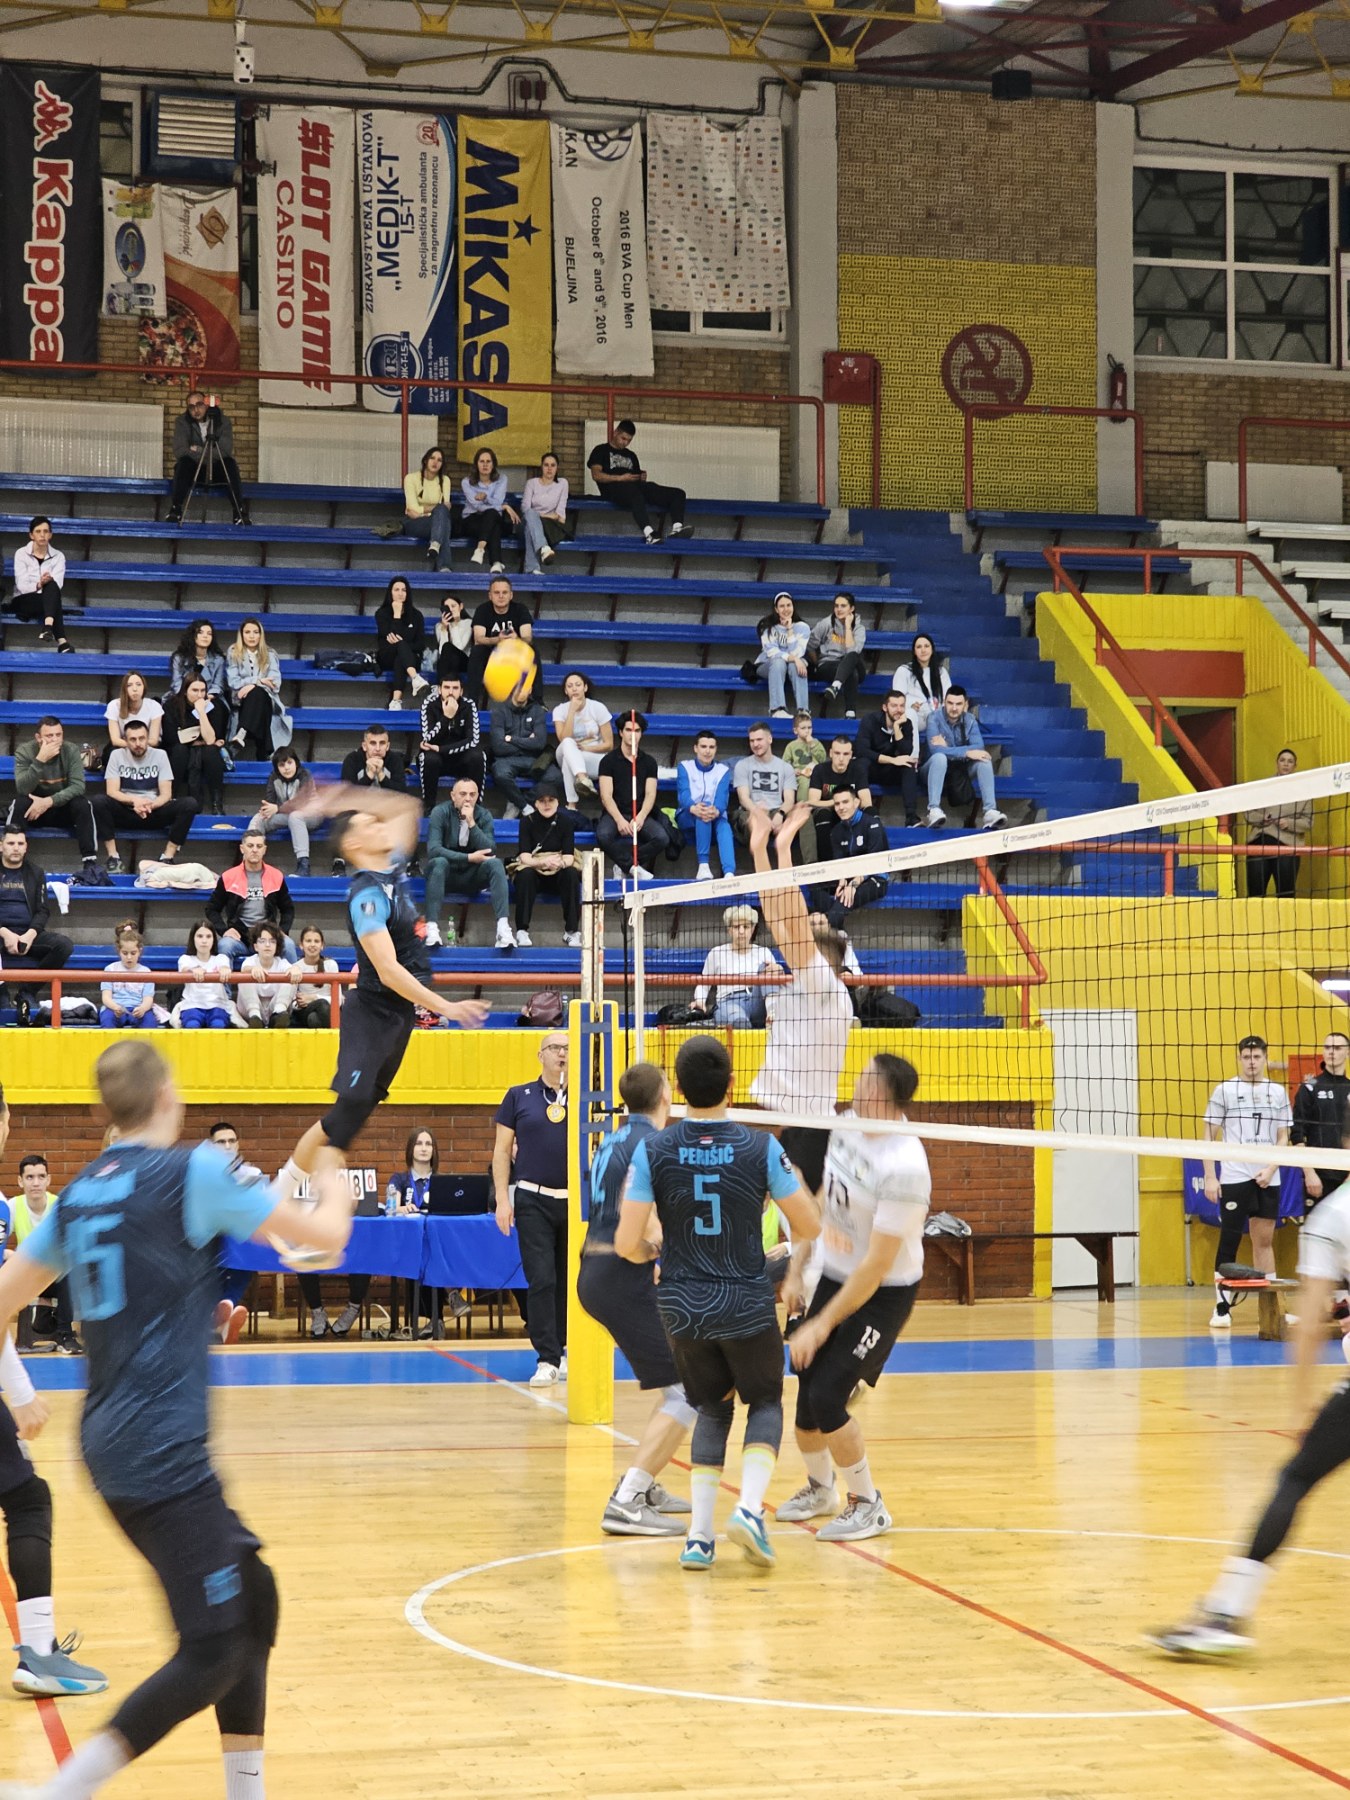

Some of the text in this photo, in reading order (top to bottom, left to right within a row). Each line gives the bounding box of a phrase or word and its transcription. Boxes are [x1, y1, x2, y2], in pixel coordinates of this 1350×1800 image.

[422, 126, 434, 141] 20
[565, 128, 578, 168] KAN
[362, 112, 374, 314] ZDRAVSTVENA USTANOVA
[418, 152, 430, 279] Specijalistička ambulanta
[430, 155, 440, 276] za magnetnu rezonancu
[591, 197, 604, 248] October
[24, 157, 73, 363] Kappa
[276, 180, 295, 329] CASINO
[564, 236, 577, 304] BIJELJINA
[593, 268, 605, 293] and
[618, 210, 634, 329] 2016 BVA Cup Men
[300, 248, 332, 393] GAME
[463, 137, 521, 442] MIKASA
[596, 315, 608, 345] 2016
[678, 1145, 734, 1166] PERIŠIĆ
[1252, 1112, 1262, 1135] 7
[693, 1174, 722, 1236] 5
[860, 1325, 881, 1350] 13
